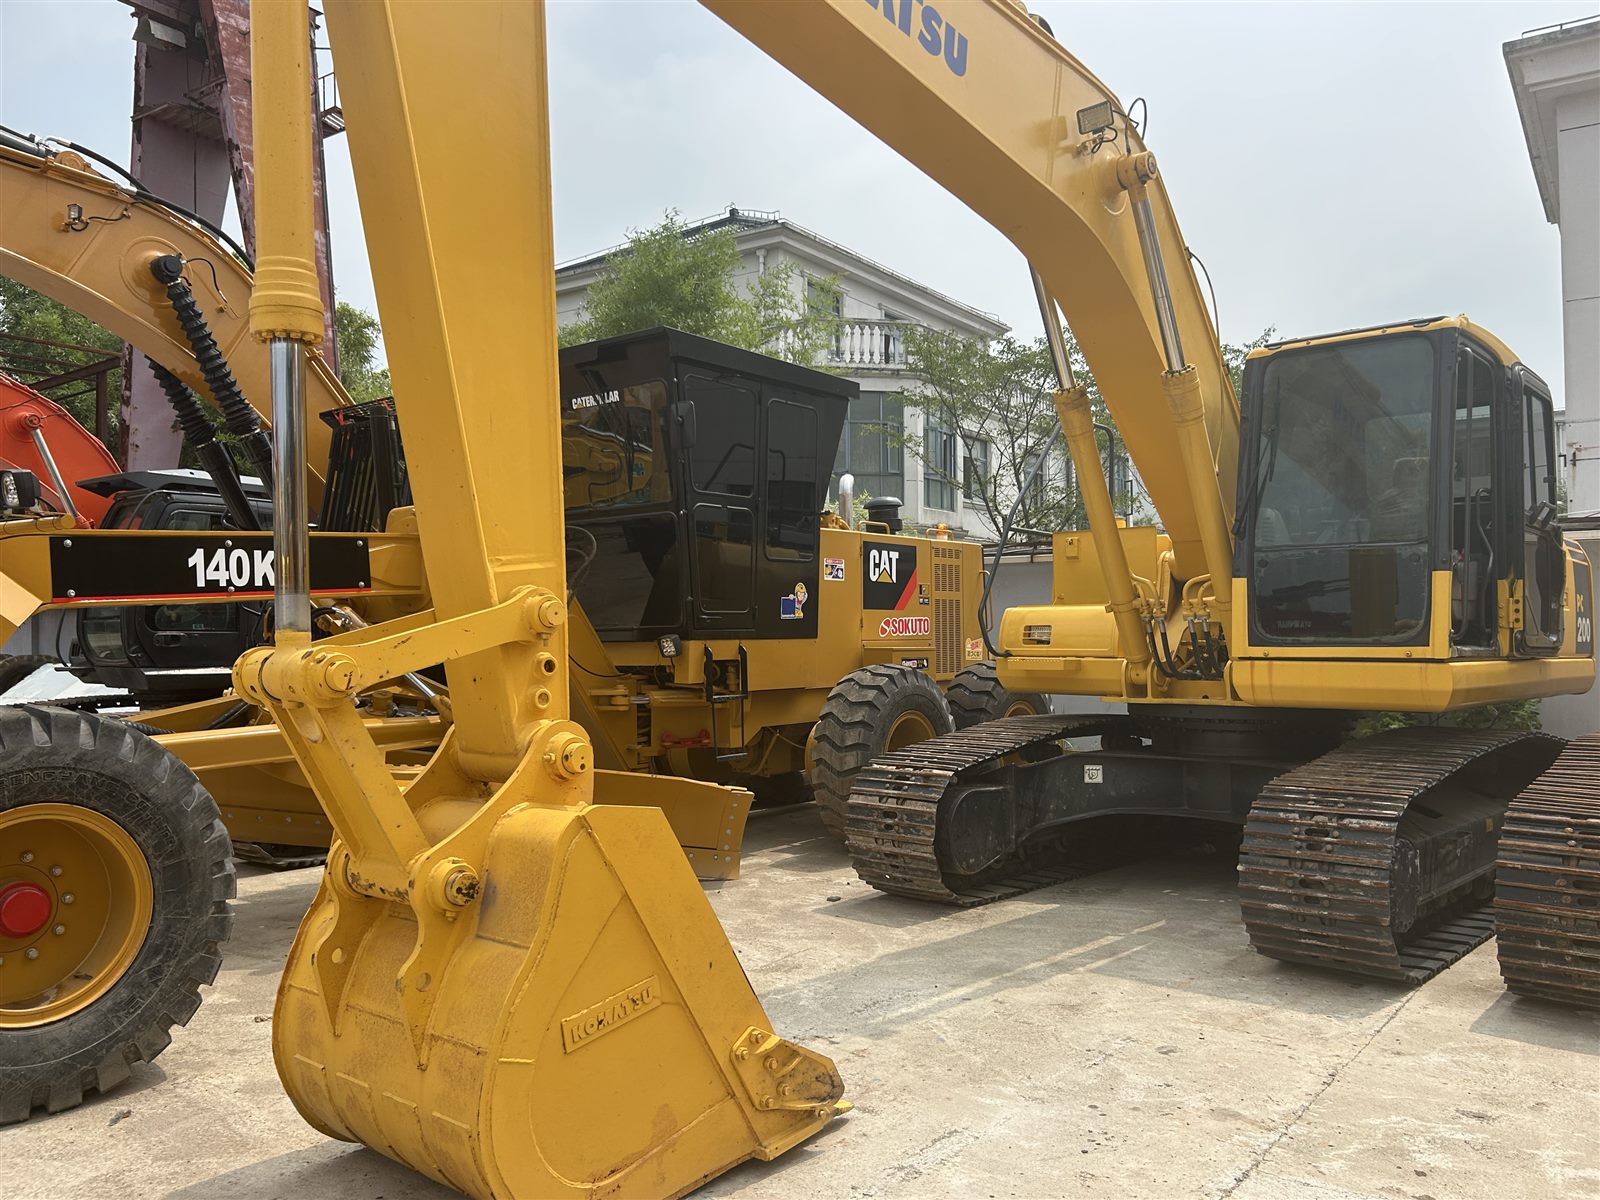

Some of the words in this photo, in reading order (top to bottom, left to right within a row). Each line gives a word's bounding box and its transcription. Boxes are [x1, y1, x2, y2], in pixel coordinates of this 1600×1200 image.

[188, 548, 275, 587] 140K
[869, 549, 899, 583] CAT
[891, 617, 930, 636] SOKUTO
[1577, 617, 1591, 643] 200
[571, 985, 654, 1043] KOMATSU
